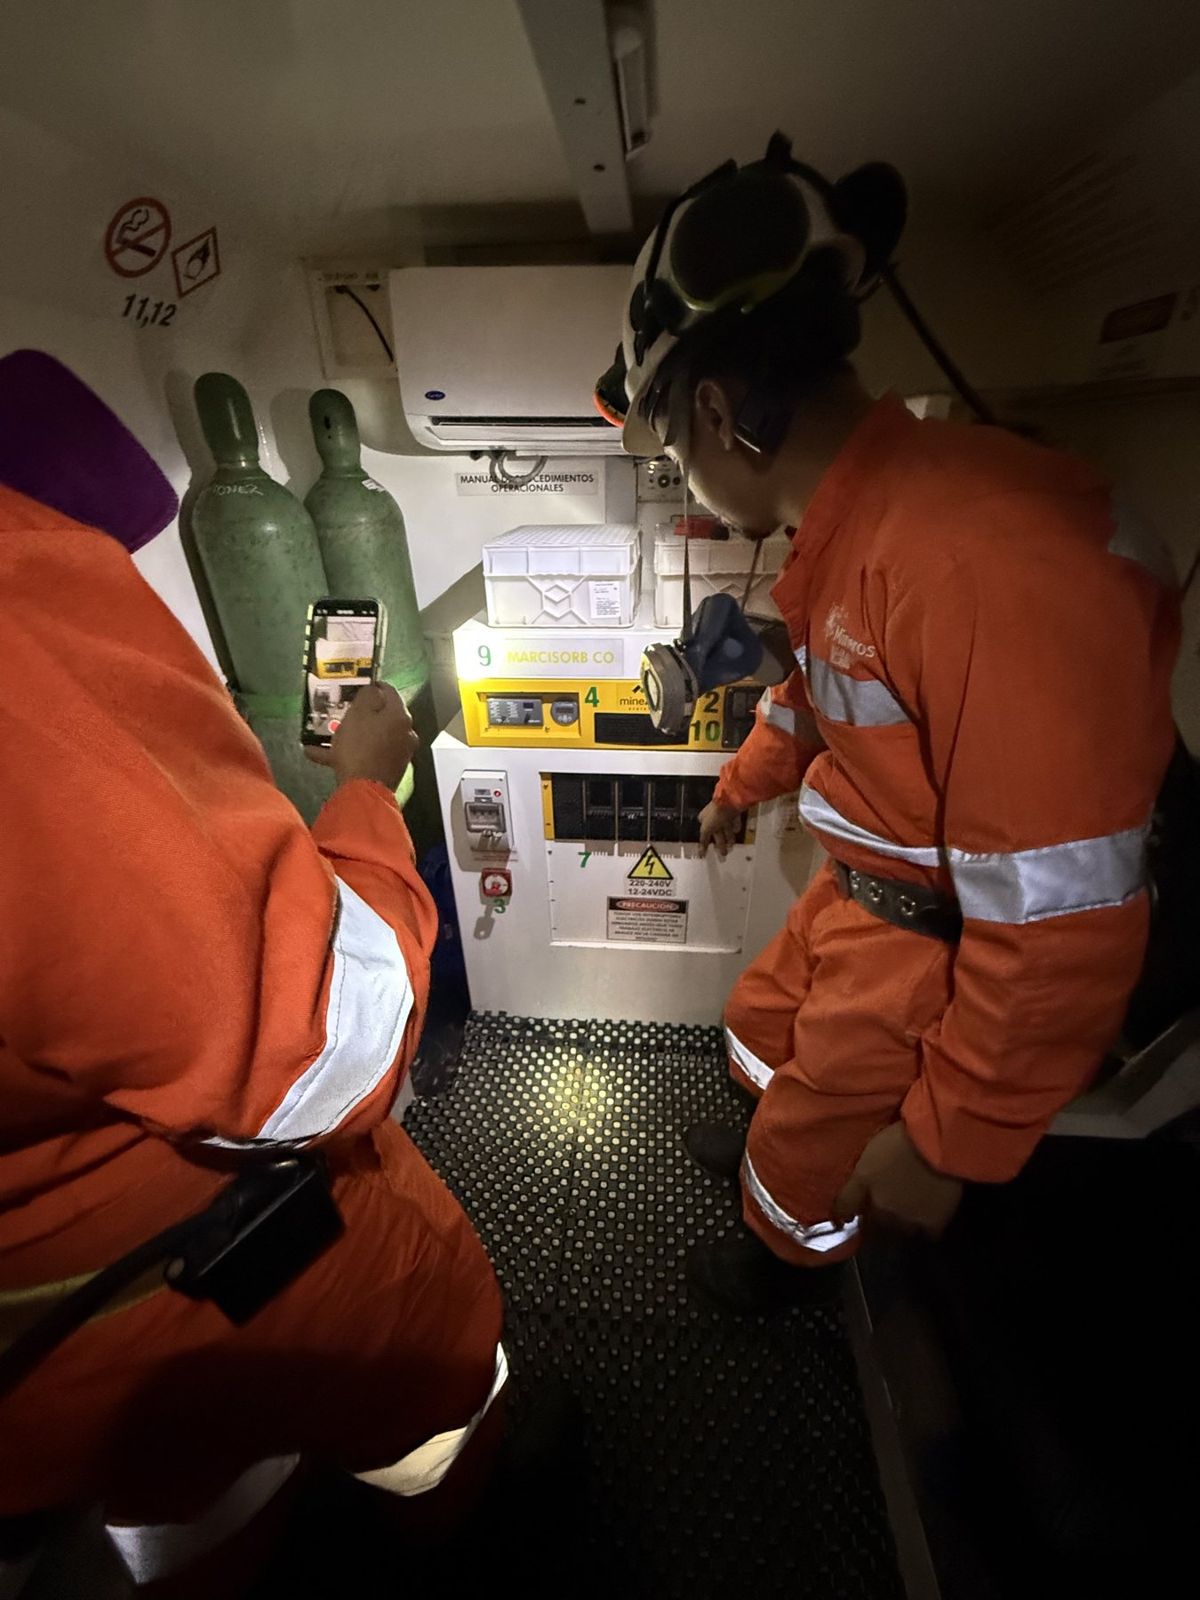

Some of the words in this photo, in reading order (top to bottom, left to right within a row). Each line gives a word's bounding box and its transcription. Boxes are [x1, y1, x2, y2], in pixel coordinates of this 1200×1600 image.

[122, 294, 177, 328] 11,12
[491, 484, 564, 493] OPERACIONALES
[477, 645, 492, 667] 9
[507, 651, 588, 664] MARCISORB
[592, 651, 614, 664] CO
[584, 686, 600, 708] 4
[703, 691, 720, 714] 2
[690, 720, 721, 742] 10
[577, 851, 591, 868] 7
[628, 888, 673, 896] 12-24VDC
[629, 880, 671, 888] 220-240V
